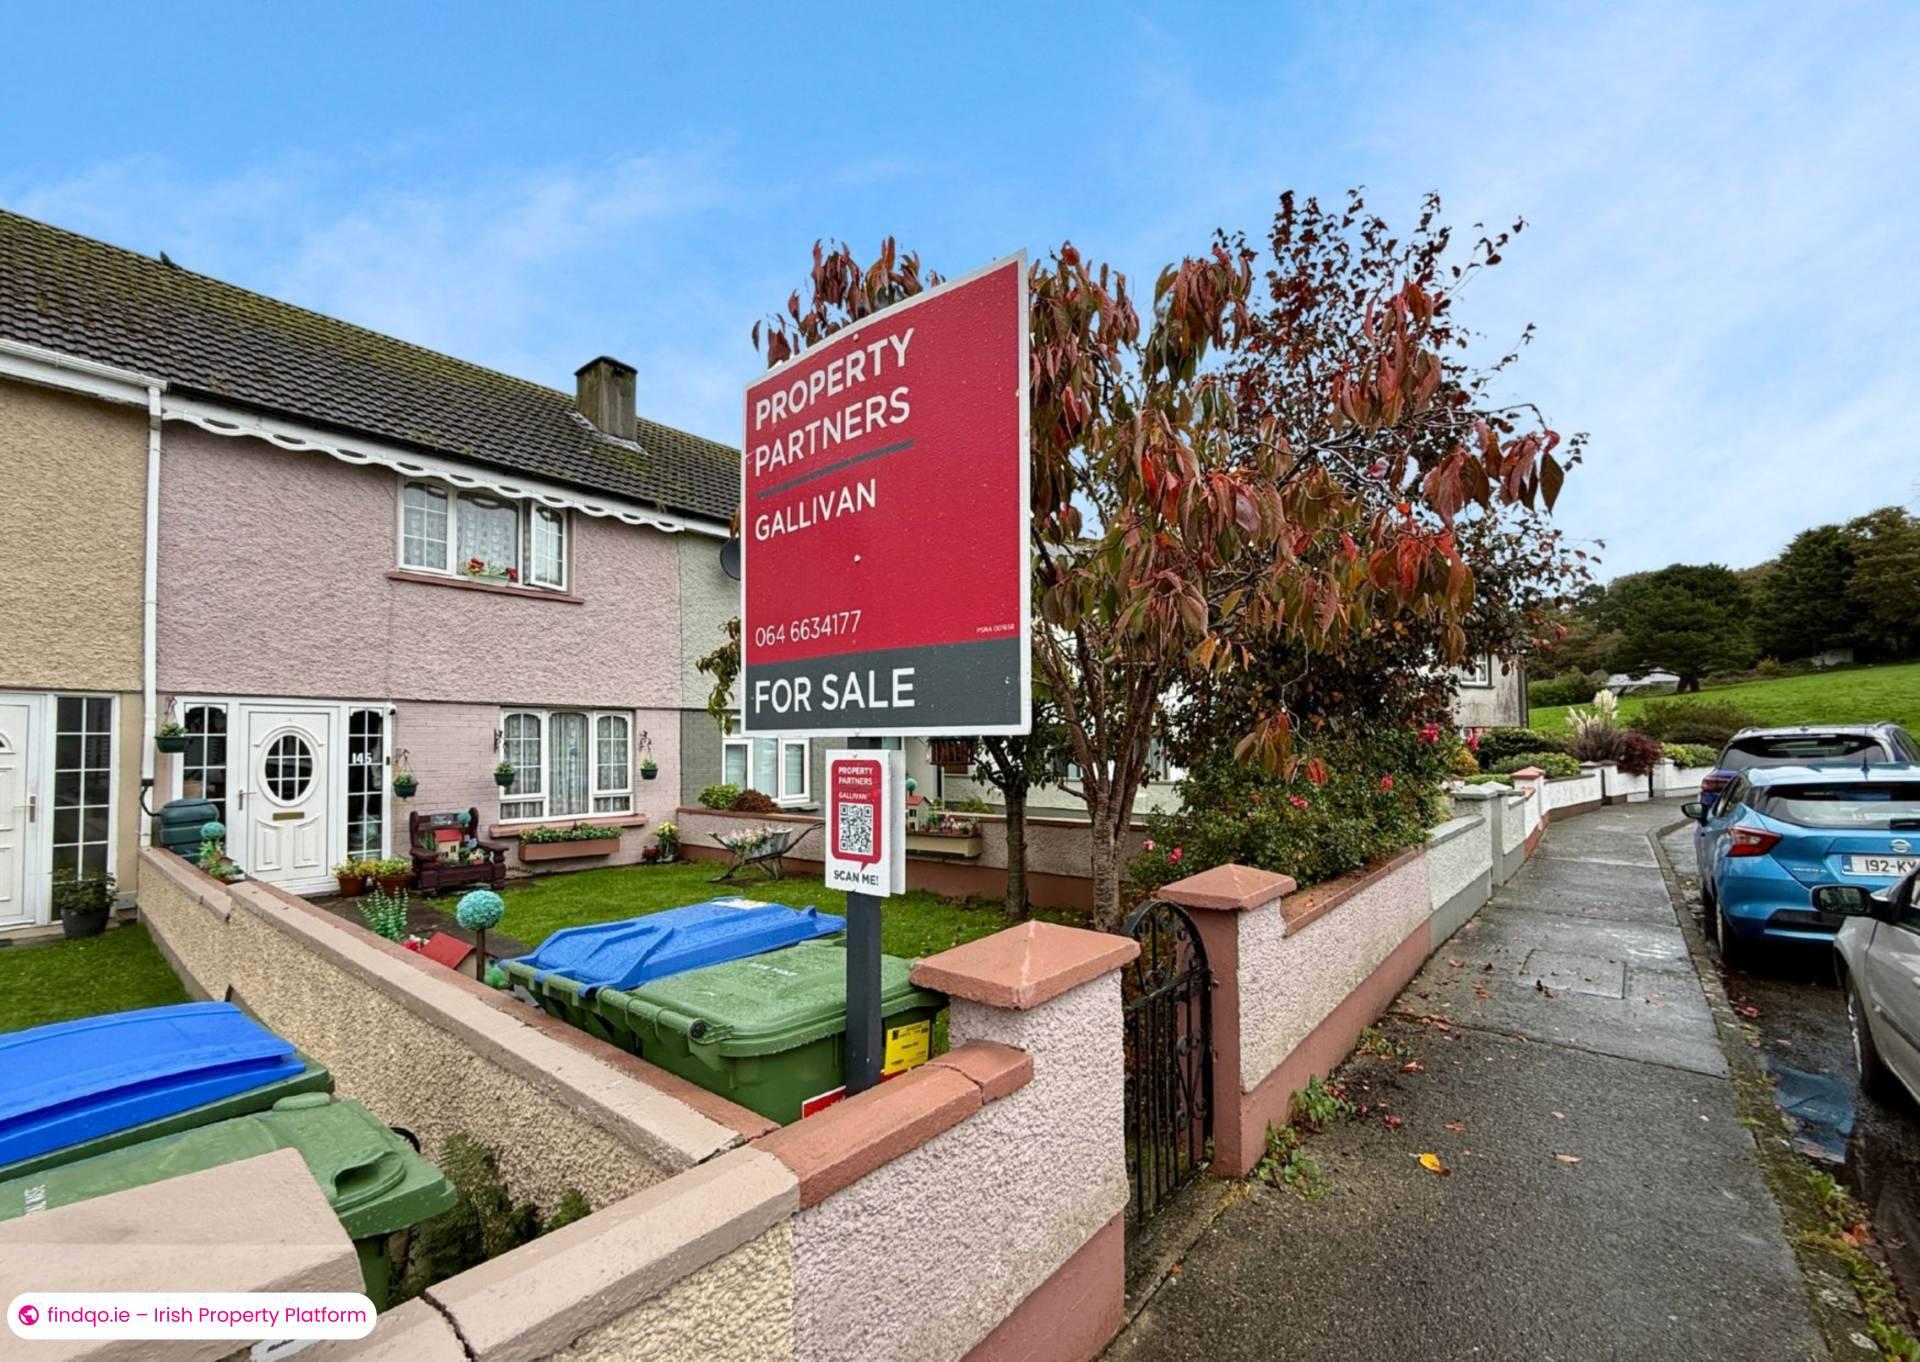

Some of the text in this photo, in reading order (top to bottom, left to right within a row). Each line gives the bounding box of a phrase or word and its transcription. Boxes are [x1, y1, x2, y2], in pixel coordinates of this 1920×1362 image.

[755, 327, 914, 431] PROPERTY
[755, 386, 911, 477] PARTNERS
[755, 478, 877, 542] GALLIVAN
[755, 609, 862, 648] 064 6634177
[755, 667, 916, 714] FOR SALE
[352, 752, 373, 765] 145
[838, 766, 874, 775] PROPERTY
[838, 776, 873, 785] PARTNERS
[838, 791, 868, 799] GALLIVAN
[833, 869, 879, 886] SCAN ME!
